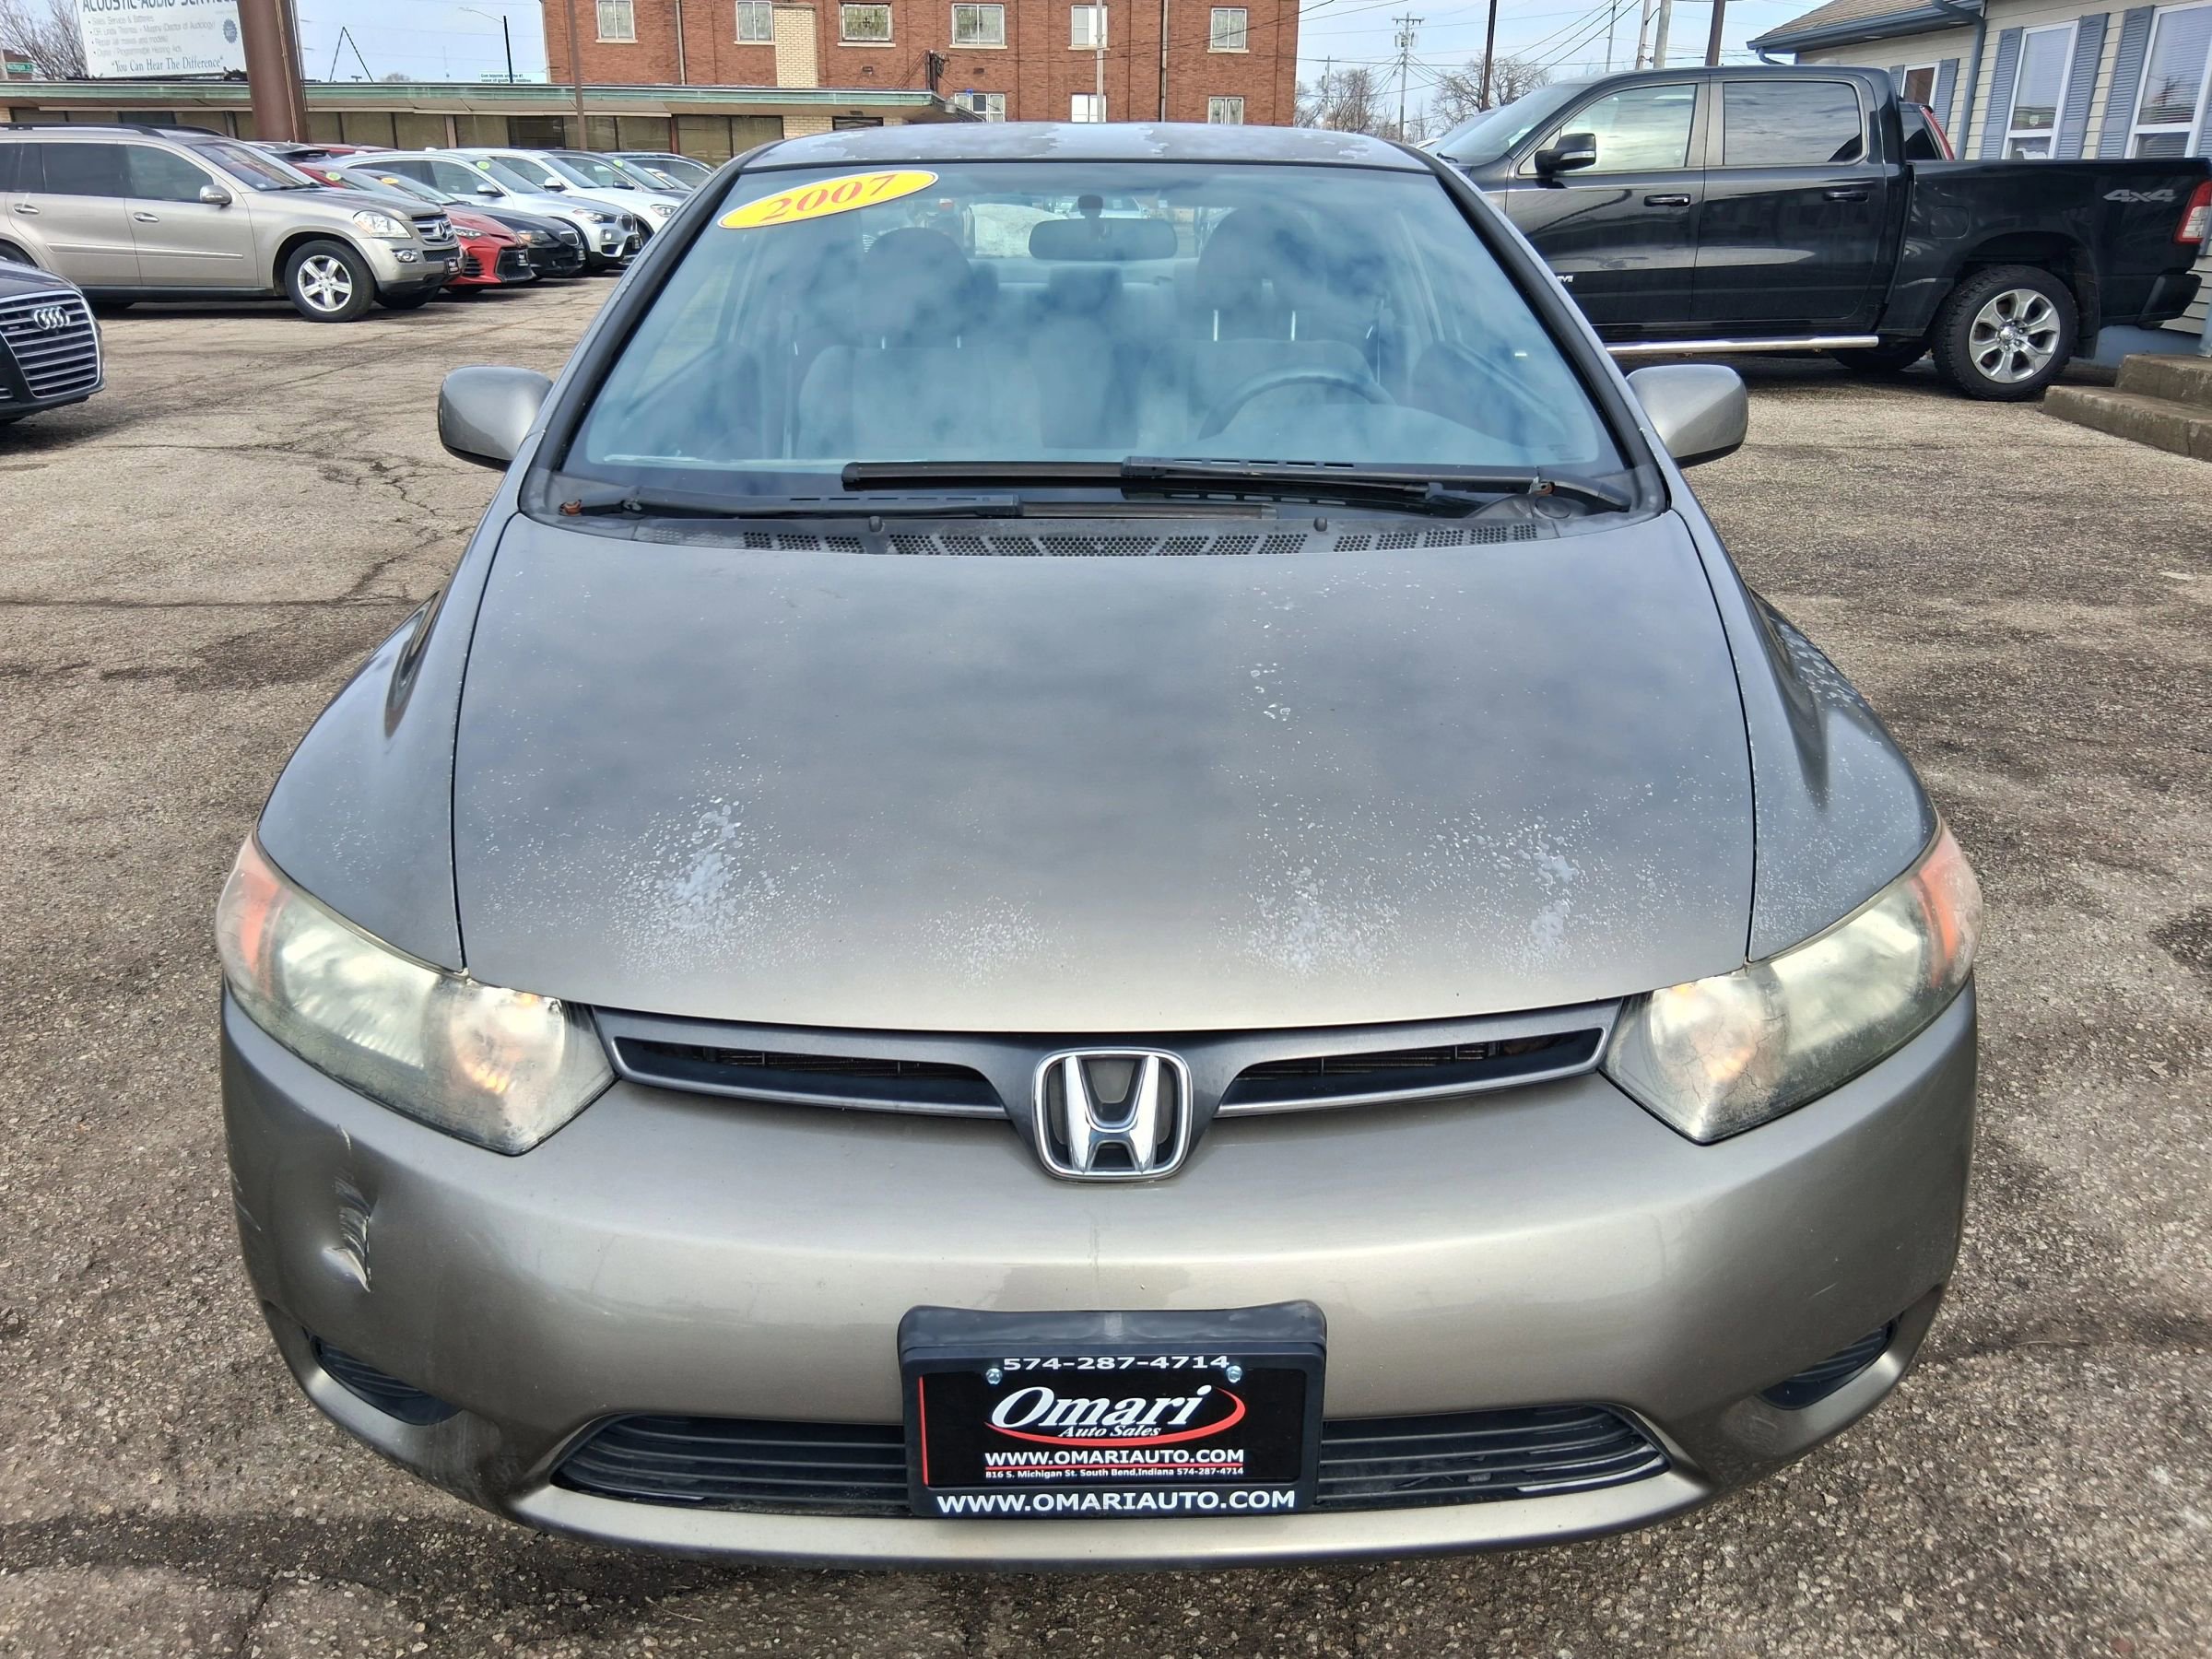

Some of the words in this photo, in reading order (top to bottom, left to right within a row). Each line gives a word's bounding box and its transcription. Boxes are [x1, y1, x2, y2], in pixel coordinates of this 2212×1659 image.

[130, 58, 144, 72] Can
[147, 57, 164, 71] Hear
[166, 56, 181, 70] The
[759, 173, 899, 222] 2007
[1003, 1355, 1230, 1371] 574-287-4714
[991, 1384, 1213, 1429] Omari
[1058, 1426, 1107, 1438] Auto
[1110, 1425, 1162, 1438] Sales
[984, 1449, 1244, 1466] WWW.OMARIAUTO.COM
[1006, 1470, 1016, 1478] S.
[1018, 1469, 1063, 1480] Michigan
[1065, 1469, 1077, 1477] St.
[1079, 1468, 1109, 1477] South
[1176, 1466, 1244, 1476] 574-287-4714
[936, 1490, 1296, 1513] WWW.OMARIAUTO.COM
